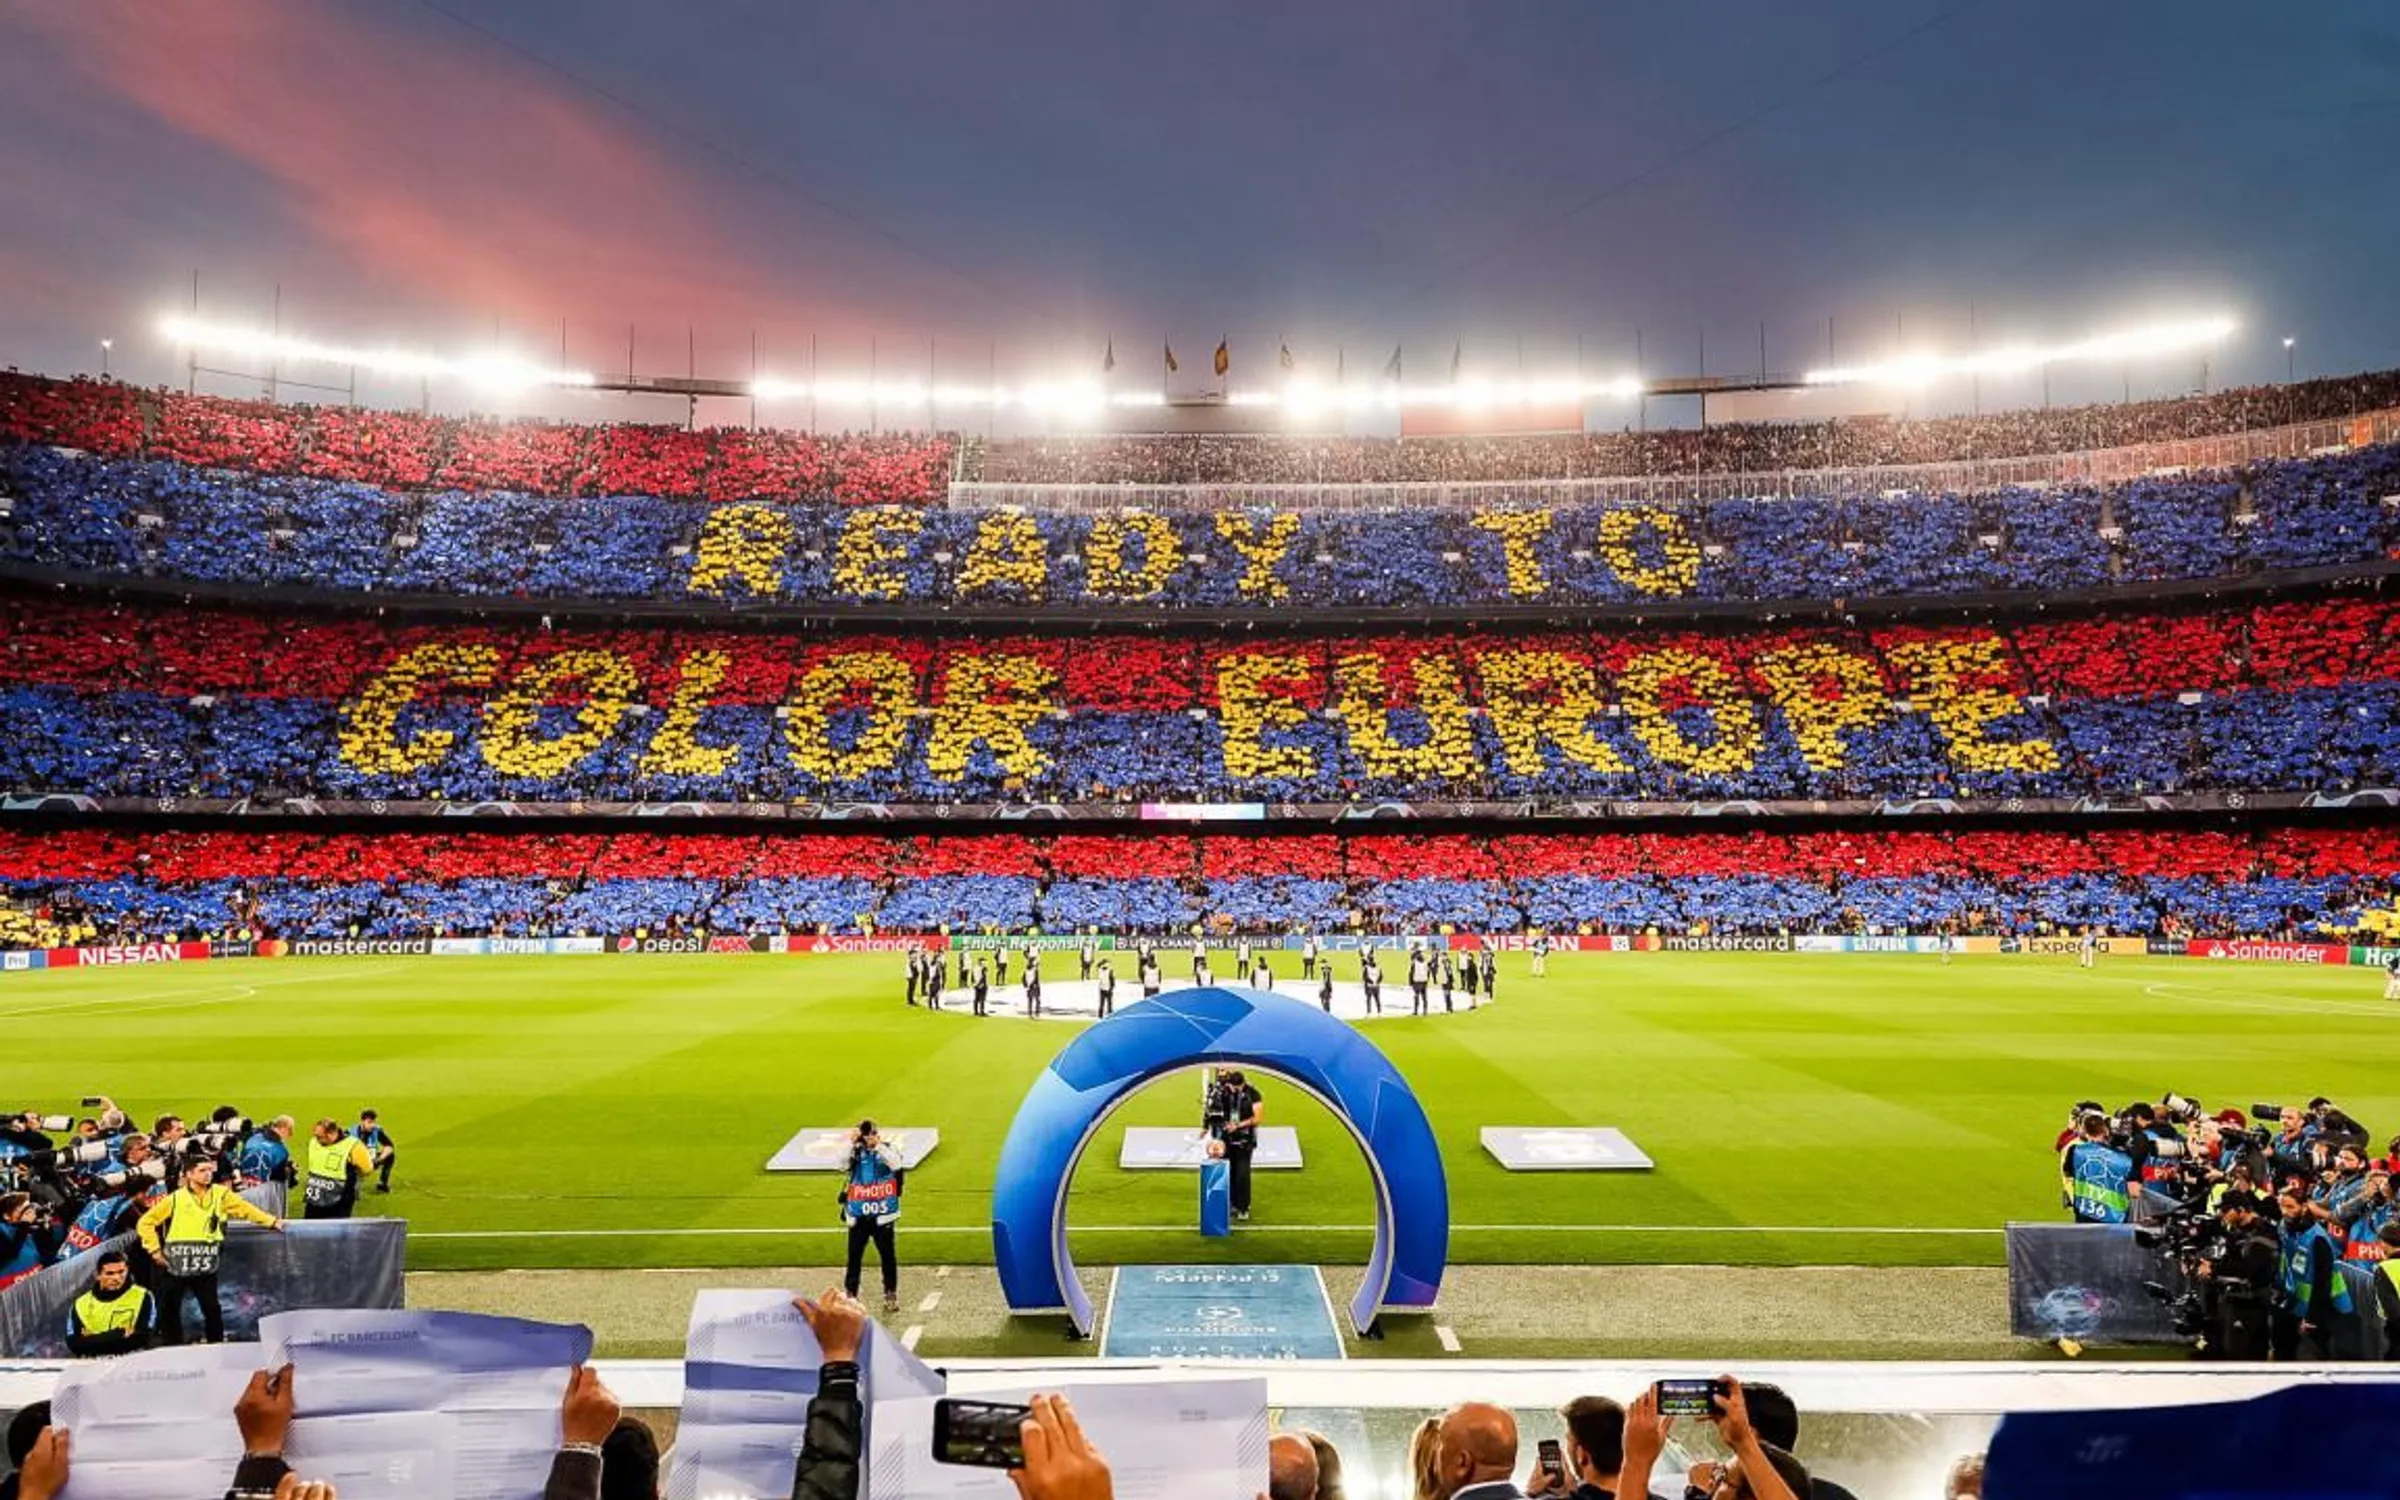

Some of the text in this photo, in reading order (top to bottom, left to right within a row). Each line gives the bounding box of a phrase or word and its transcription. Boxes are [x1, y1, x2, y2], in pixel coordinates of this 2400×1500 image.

[687, 503, 1699, 599] READY TO
[339, 637, 2060, 782] COLOR EUROPE
[295, 938, 425, 955] mastercard
[644, 937, 702, 954] pepsi
[1667, 936, 1788, 951] mastercard
[2227, 942, 2327, 963] Santander
[78, 944, 181, 964] NISSAN
[854, 1183, 893, 1197] PHOTO
[2080, 1198, 2106, 1217] 136
[181, 1256, 212, 1272] 155
